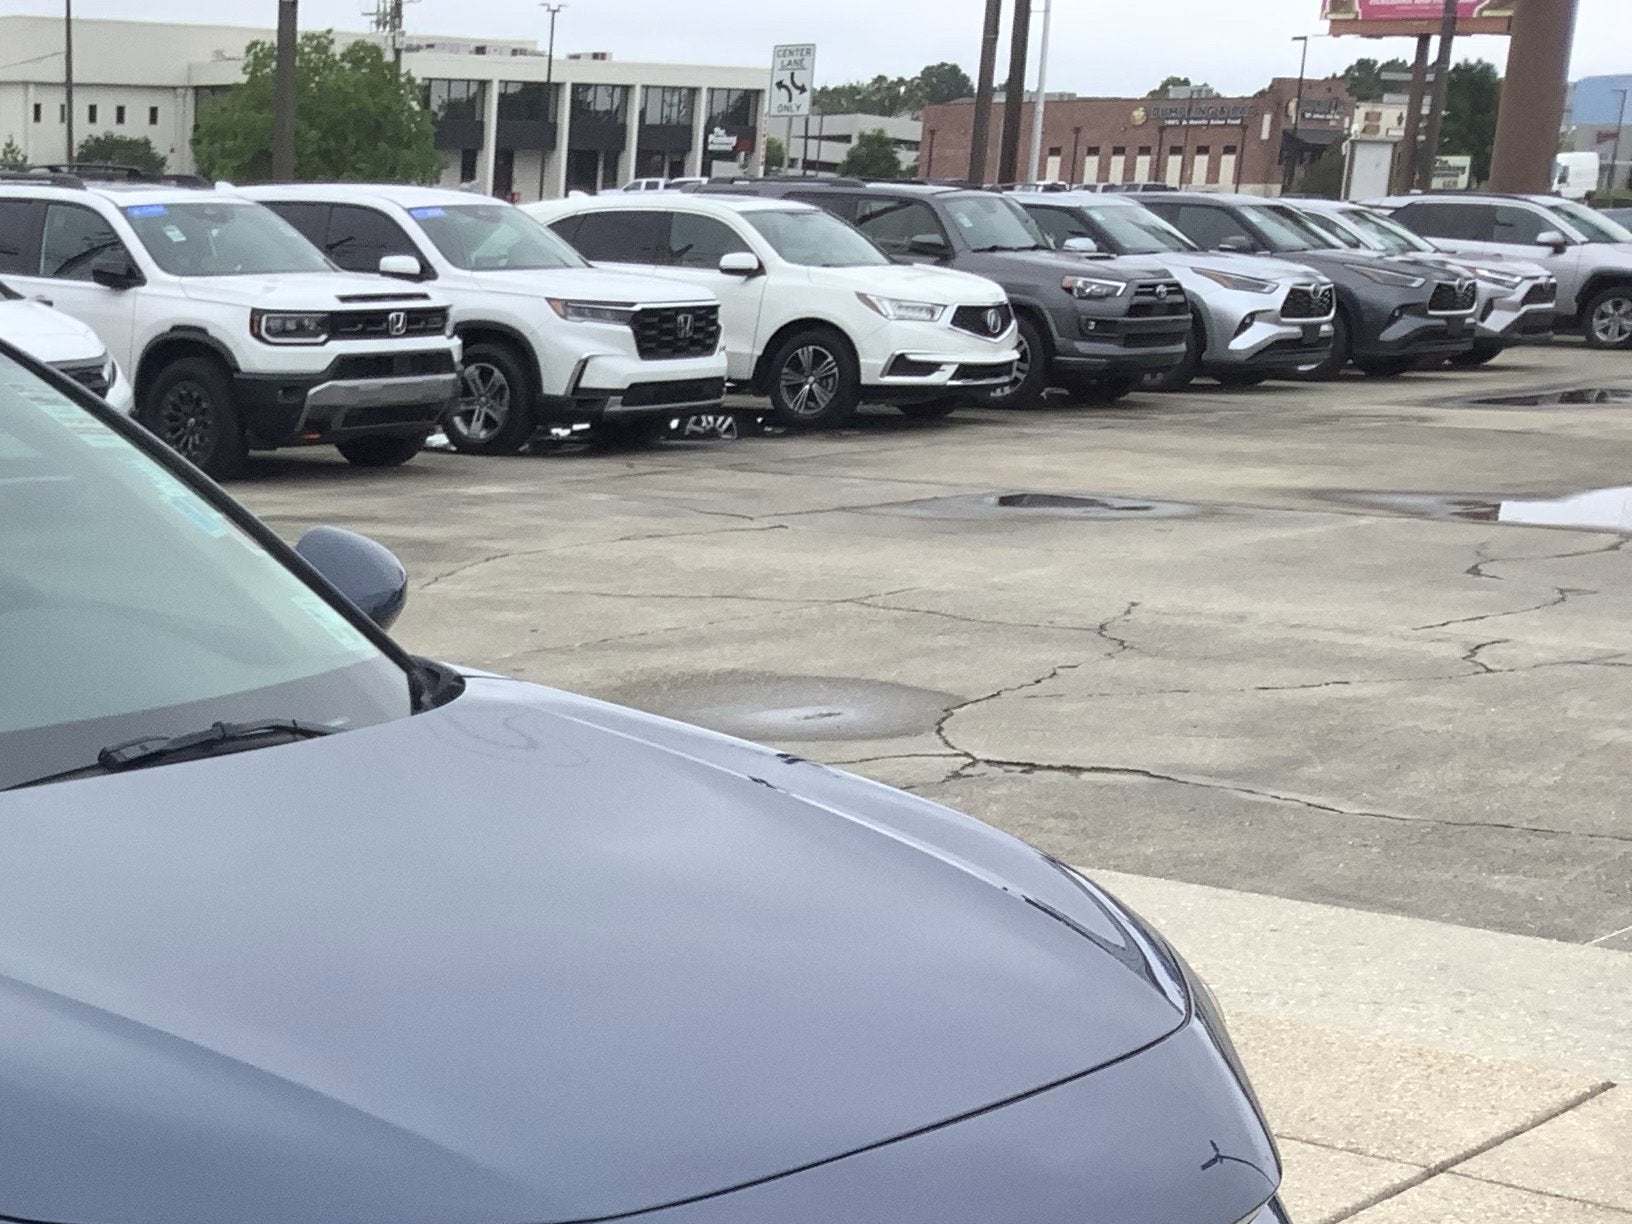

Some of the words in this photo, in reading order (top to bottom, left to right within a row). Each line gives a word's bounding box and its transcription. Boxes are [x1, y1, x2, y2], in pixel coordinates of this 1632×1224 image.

[776, 47, 812, 58] CENTER
[781, 57, 806, 69] LANE
[777, 103, 802, 113] ONLY
